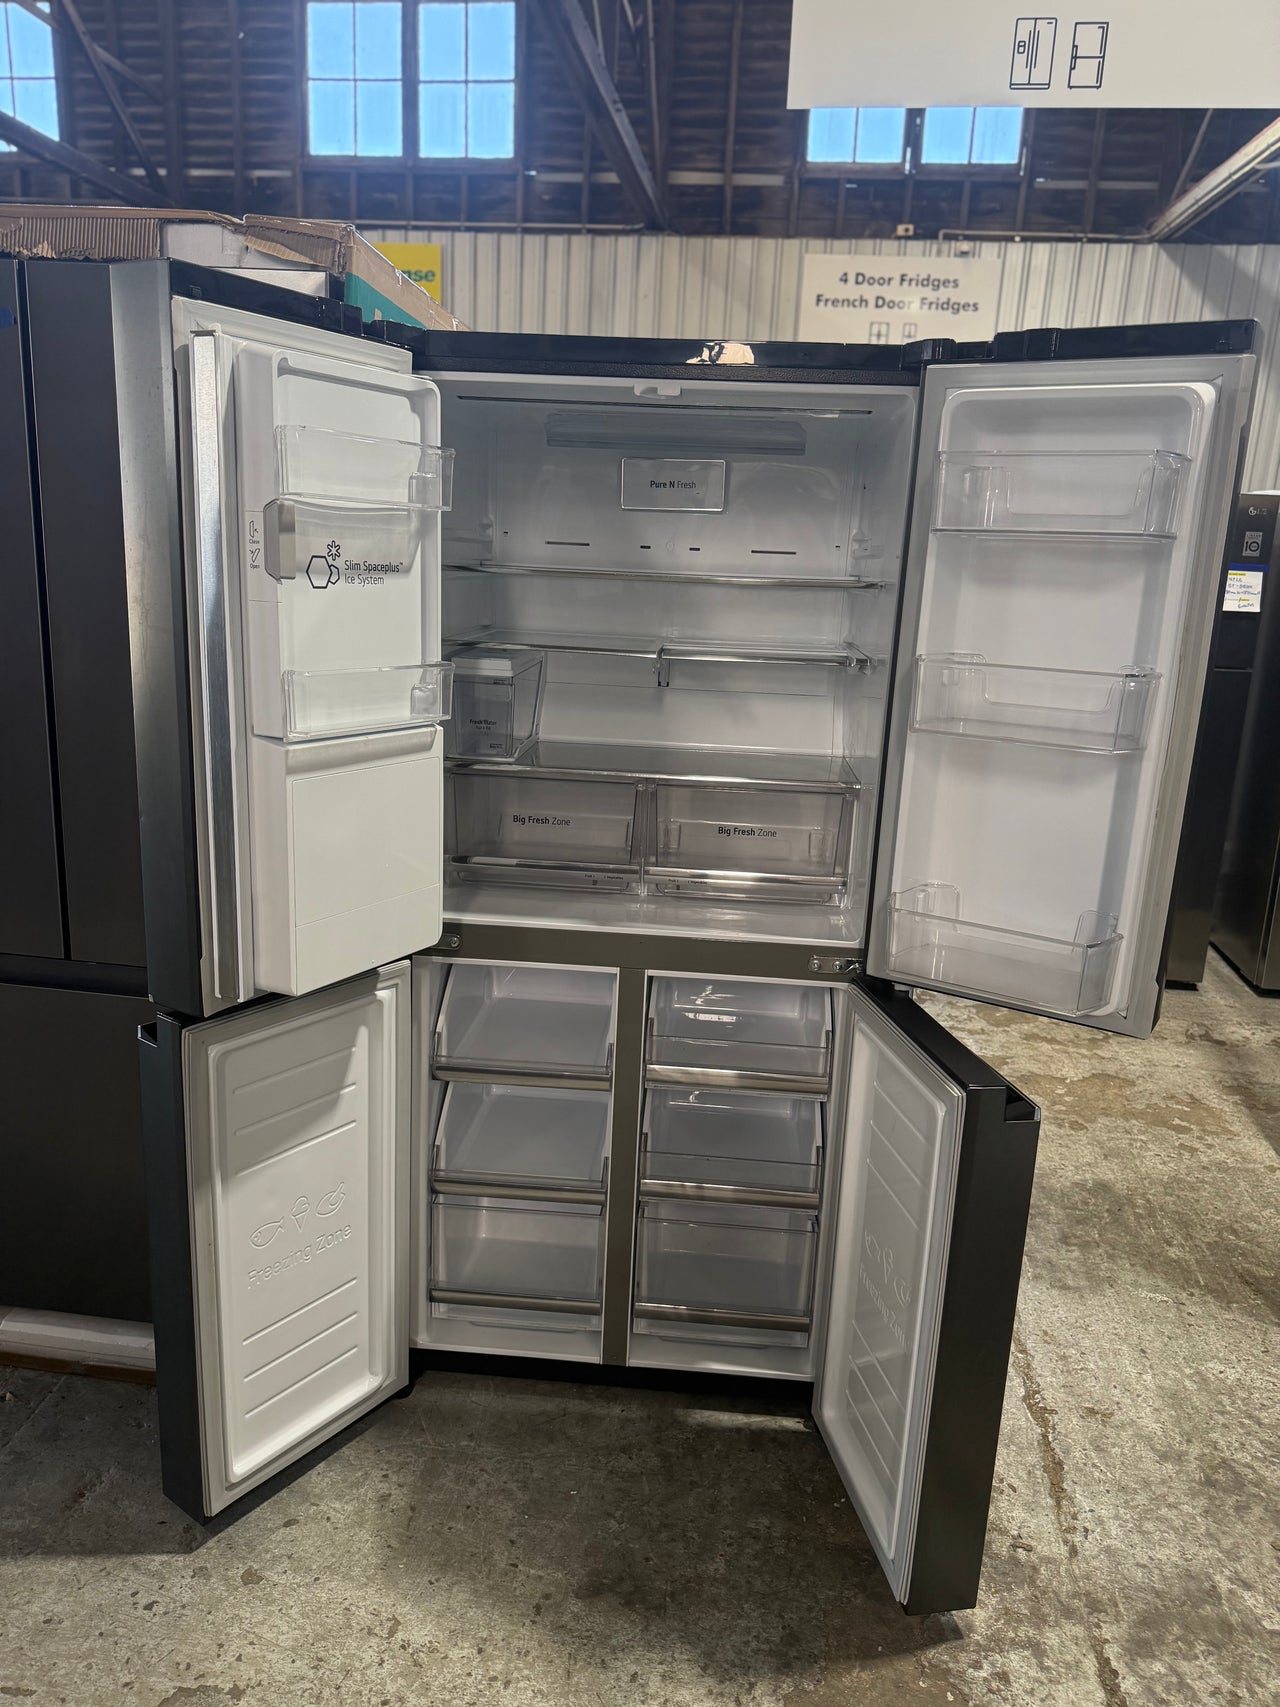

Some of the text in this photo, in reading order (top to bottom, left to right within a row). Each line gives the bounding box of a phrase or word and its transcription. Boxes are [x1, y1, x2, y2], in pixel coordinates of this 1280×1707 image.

[839, 272, 960, 291] 4 Door Fridges
[815, 294, 979, 314] French Door Fridges
[650, 480, 697, 489] Pure N Fresh
[344, 559, 361, 571] Slim
[344, 573, 385, 588] Ice System
[512, 814, 571, 826] Big Fresh Zone
[718, 826, 777, 838] Big Fresh Zone
[248, 1224, 352, 1289] Freezing Zone
